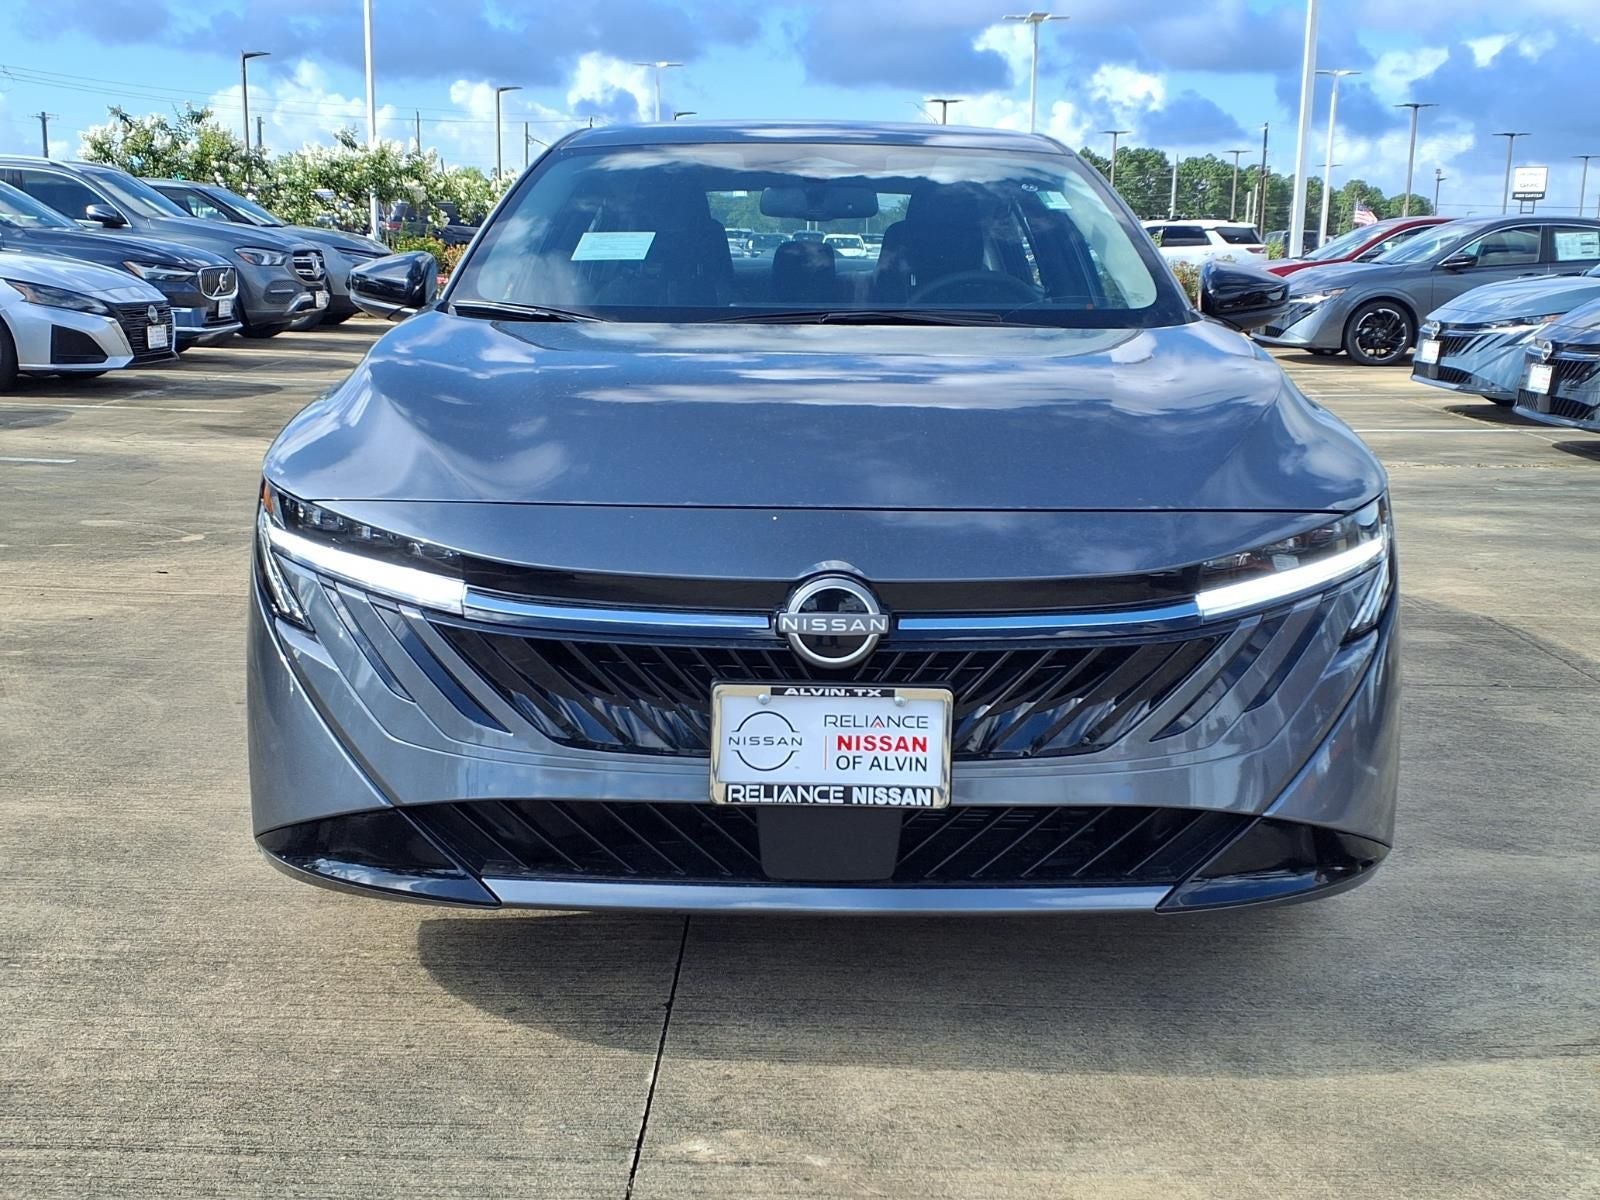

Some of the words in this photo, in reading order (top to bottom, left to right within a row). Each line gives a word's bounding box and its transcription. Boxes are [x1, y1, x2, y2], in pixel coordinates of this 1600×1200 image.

[782, 617, 887, 632] NISSAN
[854, 689, 882, 697] TX
[824, 714, 929, 729] RELIANCE
[728, 736, 803, 746] NISSAN
[837, 735, 928, 753] NISSAN
[836, 755, 861, 770] OF
[869, 756, 928, 772] ALVIN
[727, 784, 844, 804] RELIANCE
[852, 787, 932, 806] NISSAN
